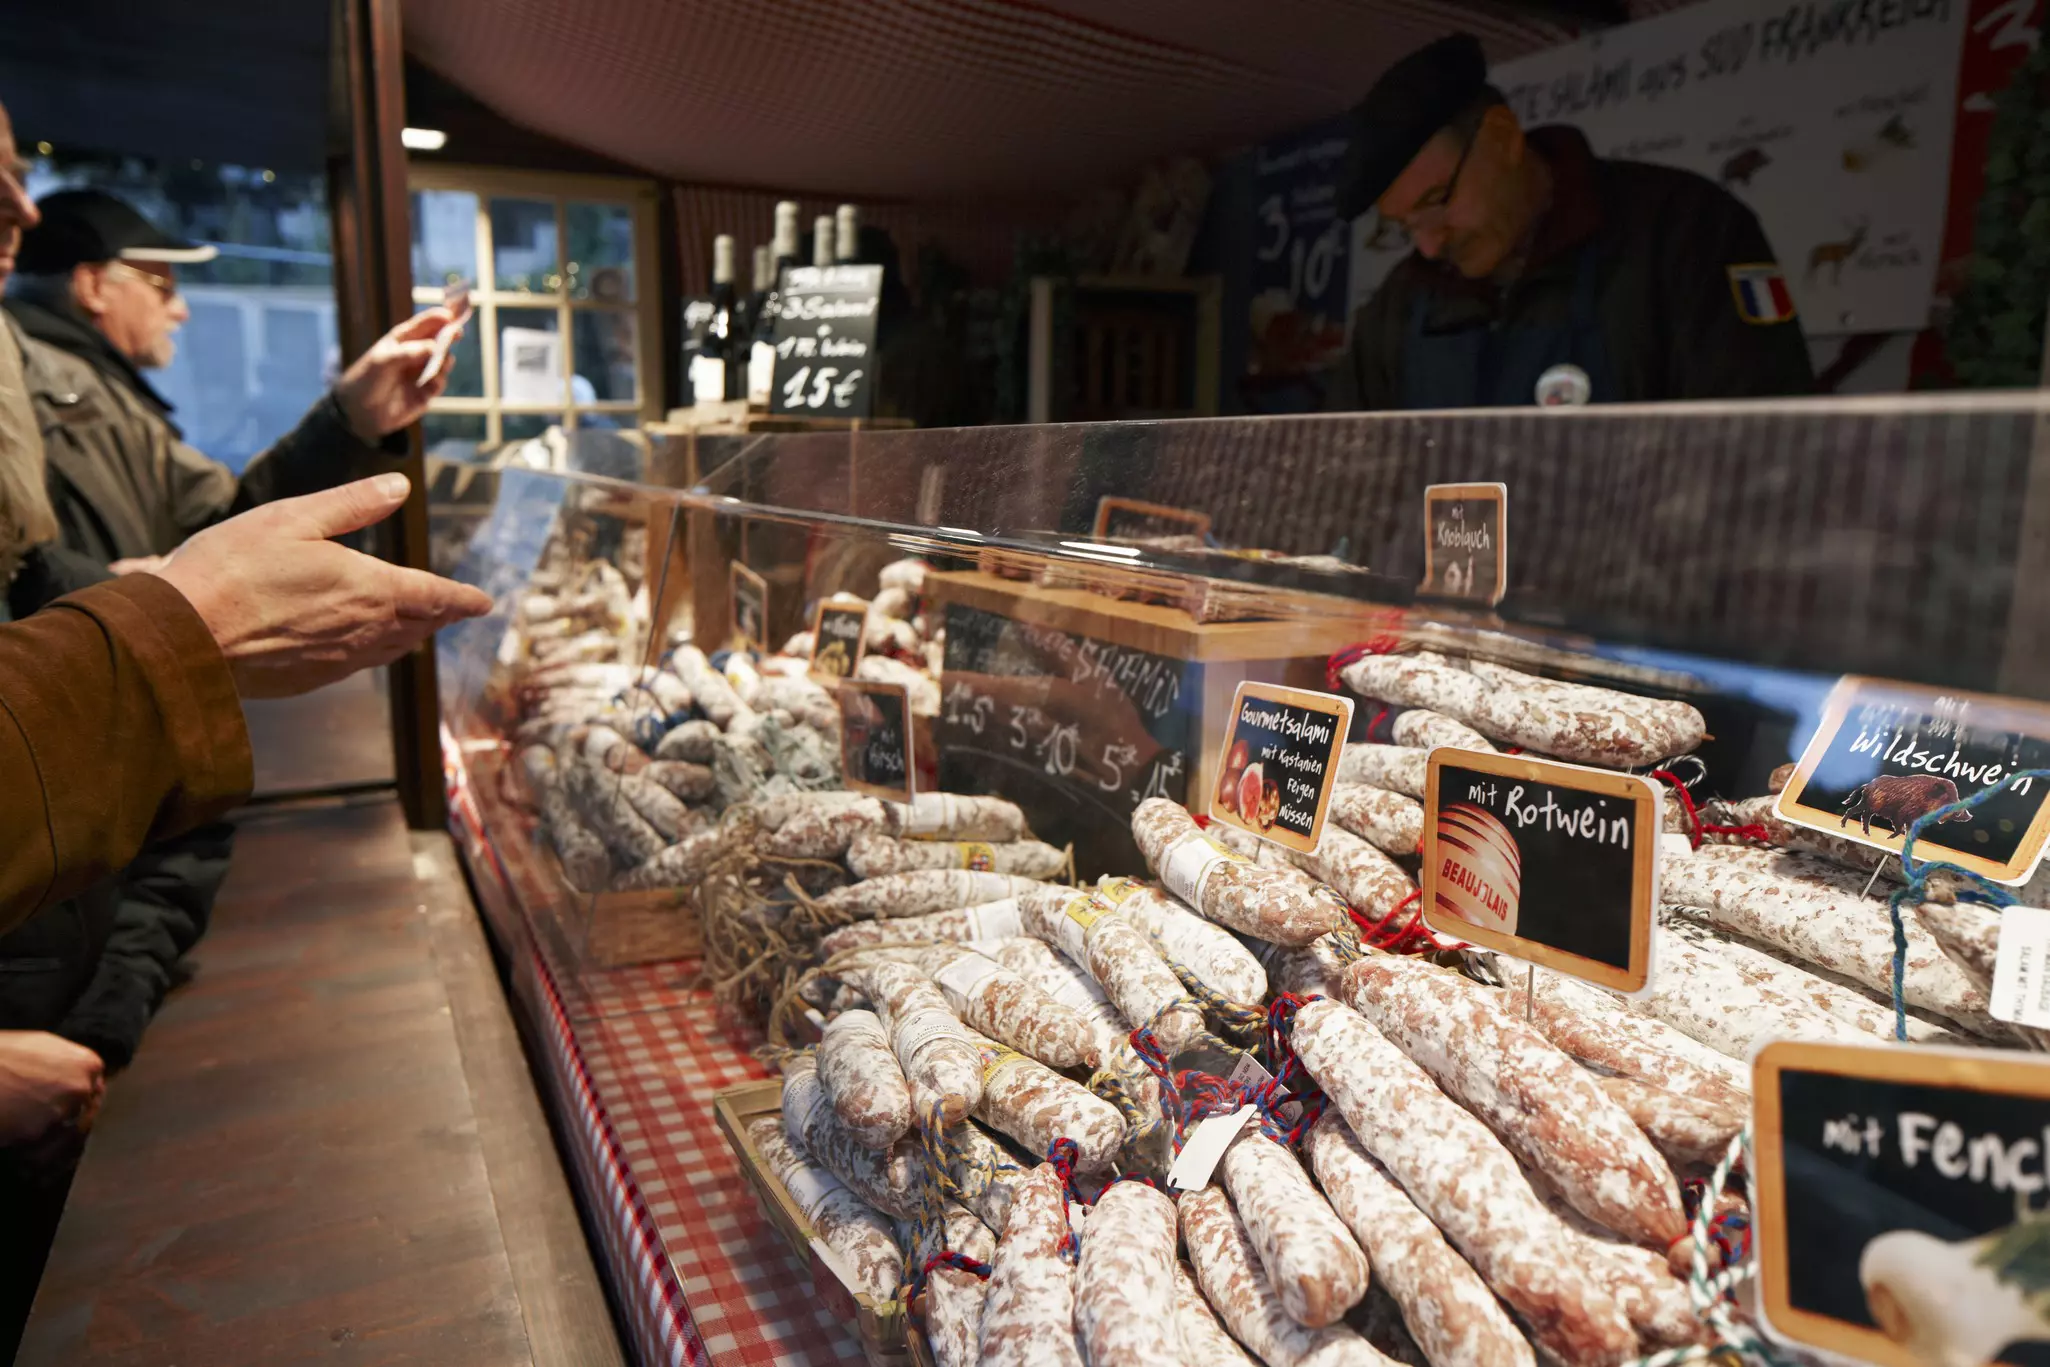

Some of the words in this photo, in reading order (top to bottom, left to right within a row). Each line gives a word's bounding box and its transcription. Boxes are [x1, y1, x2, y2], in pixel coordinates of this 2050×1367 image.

[1437, 519, 1490, 554] Knoblauch
[1240, 702, 1331, 746] Gourmetsalami
[1261, 743, 1278, 761] mit
[1279, 749, 1322, 776] Kastanien
[1849, 731, 2033, 797] Wildschwein
[1287, 777, 1316, 804] Feigen
[1278, 802, 1314, 832] Nüssen
[1468, 781, 1498, 807] mit
[1504, 785, 1630, 850] Rotwein
[1822, 1112, 1885, 1158] mit
